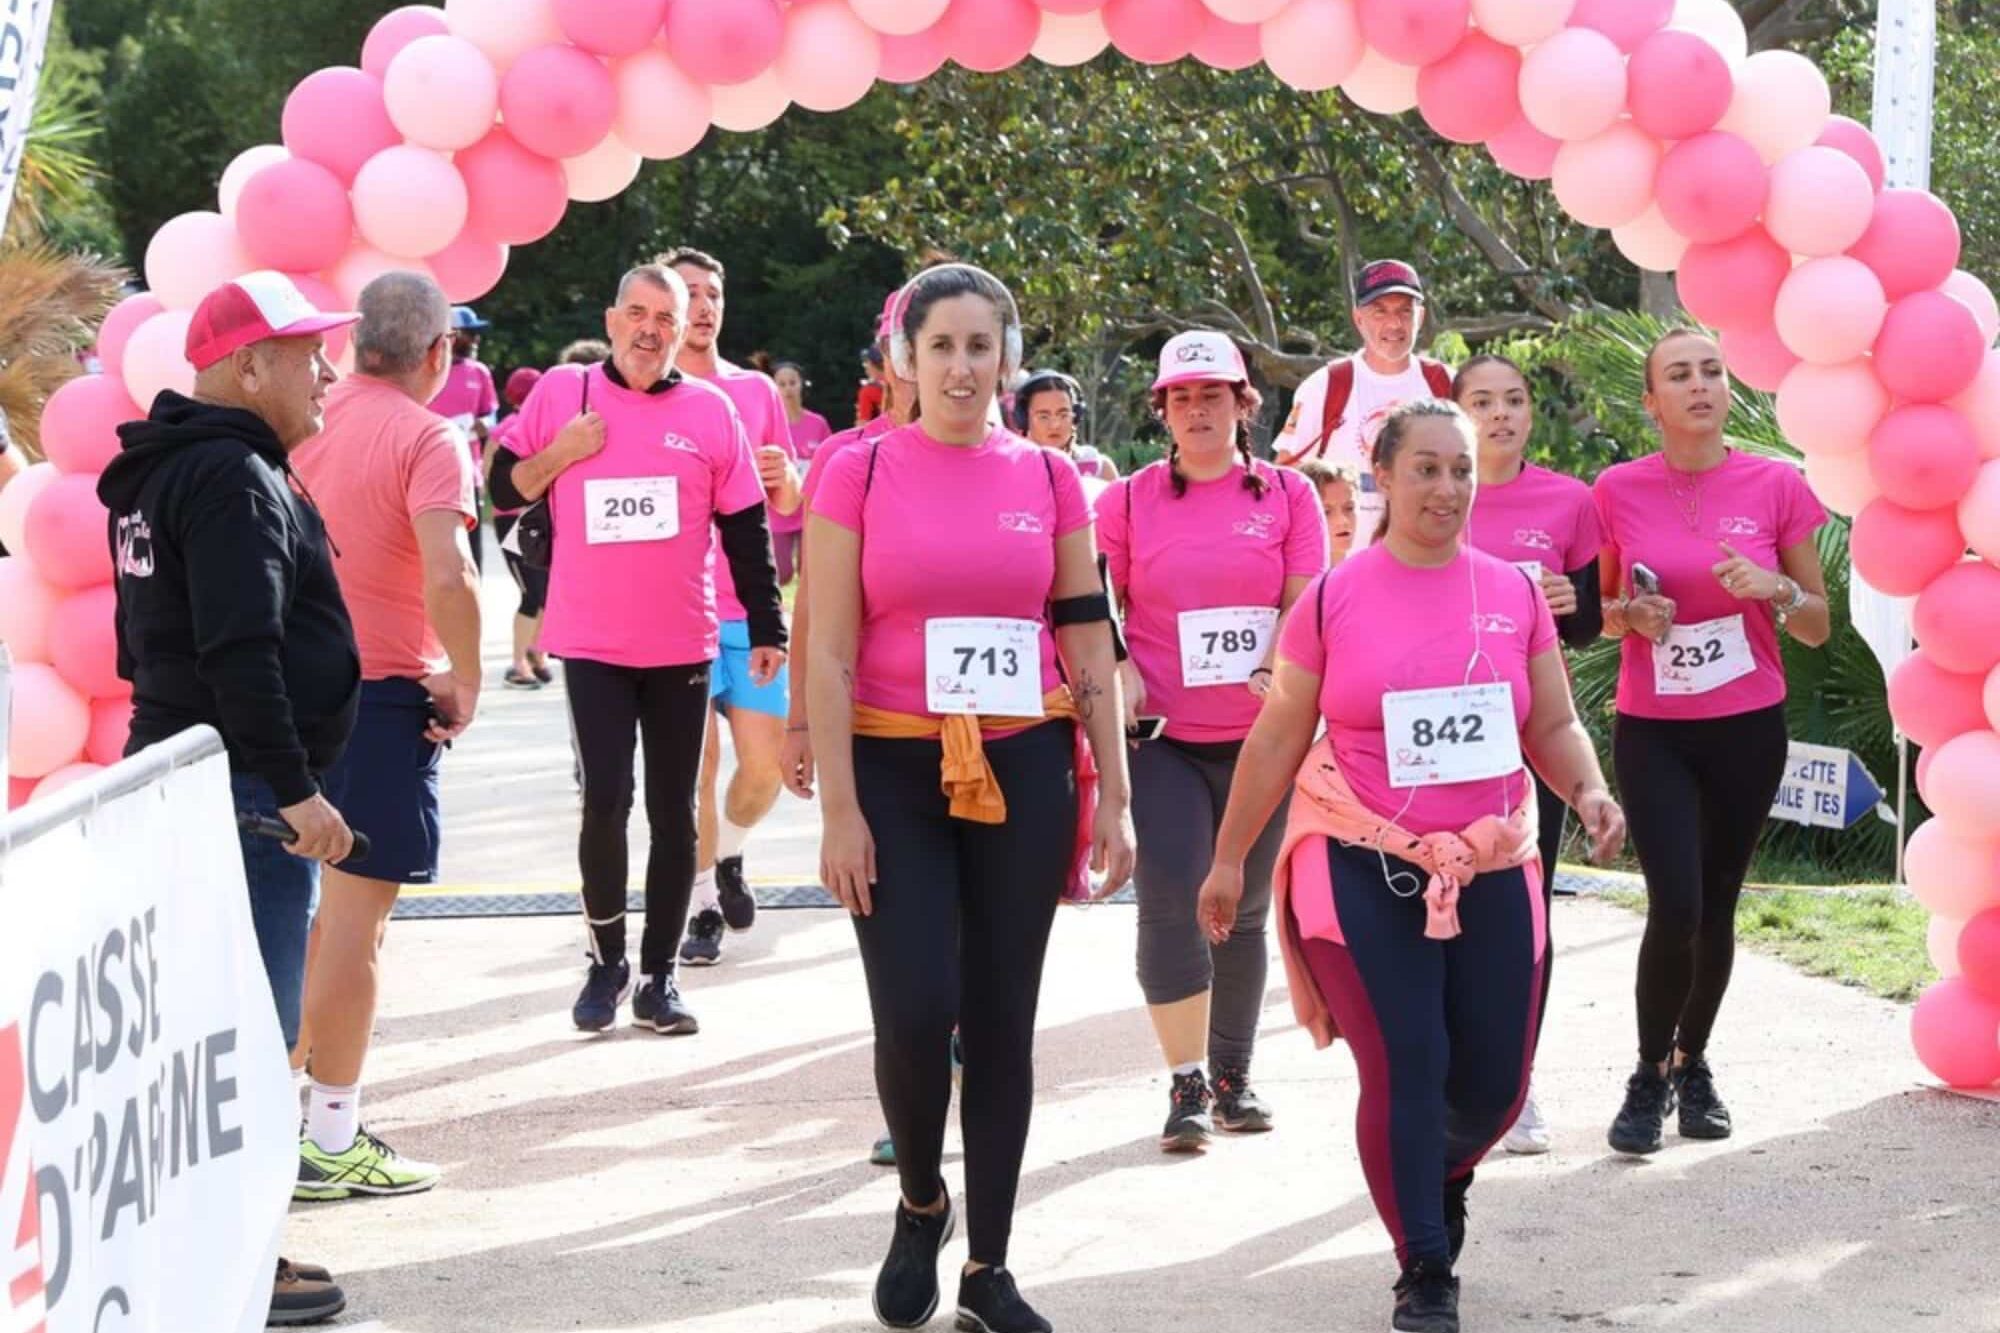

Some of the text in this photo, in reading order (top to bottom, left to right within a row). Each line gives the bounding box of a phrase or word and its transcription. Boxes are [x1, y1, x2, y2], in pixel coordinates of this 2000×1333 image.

[604, 497, 655, 518] 206
[1200, 628, 1257, 655] 789
[1670, 638, 1725, 668] 232
[953, 646, 1019, 677] 713
[1412, 713, 1485, 748] 842
[1792, 759, 1837, 785] ETTE
[27, 905, 161, 1124] CASSE
